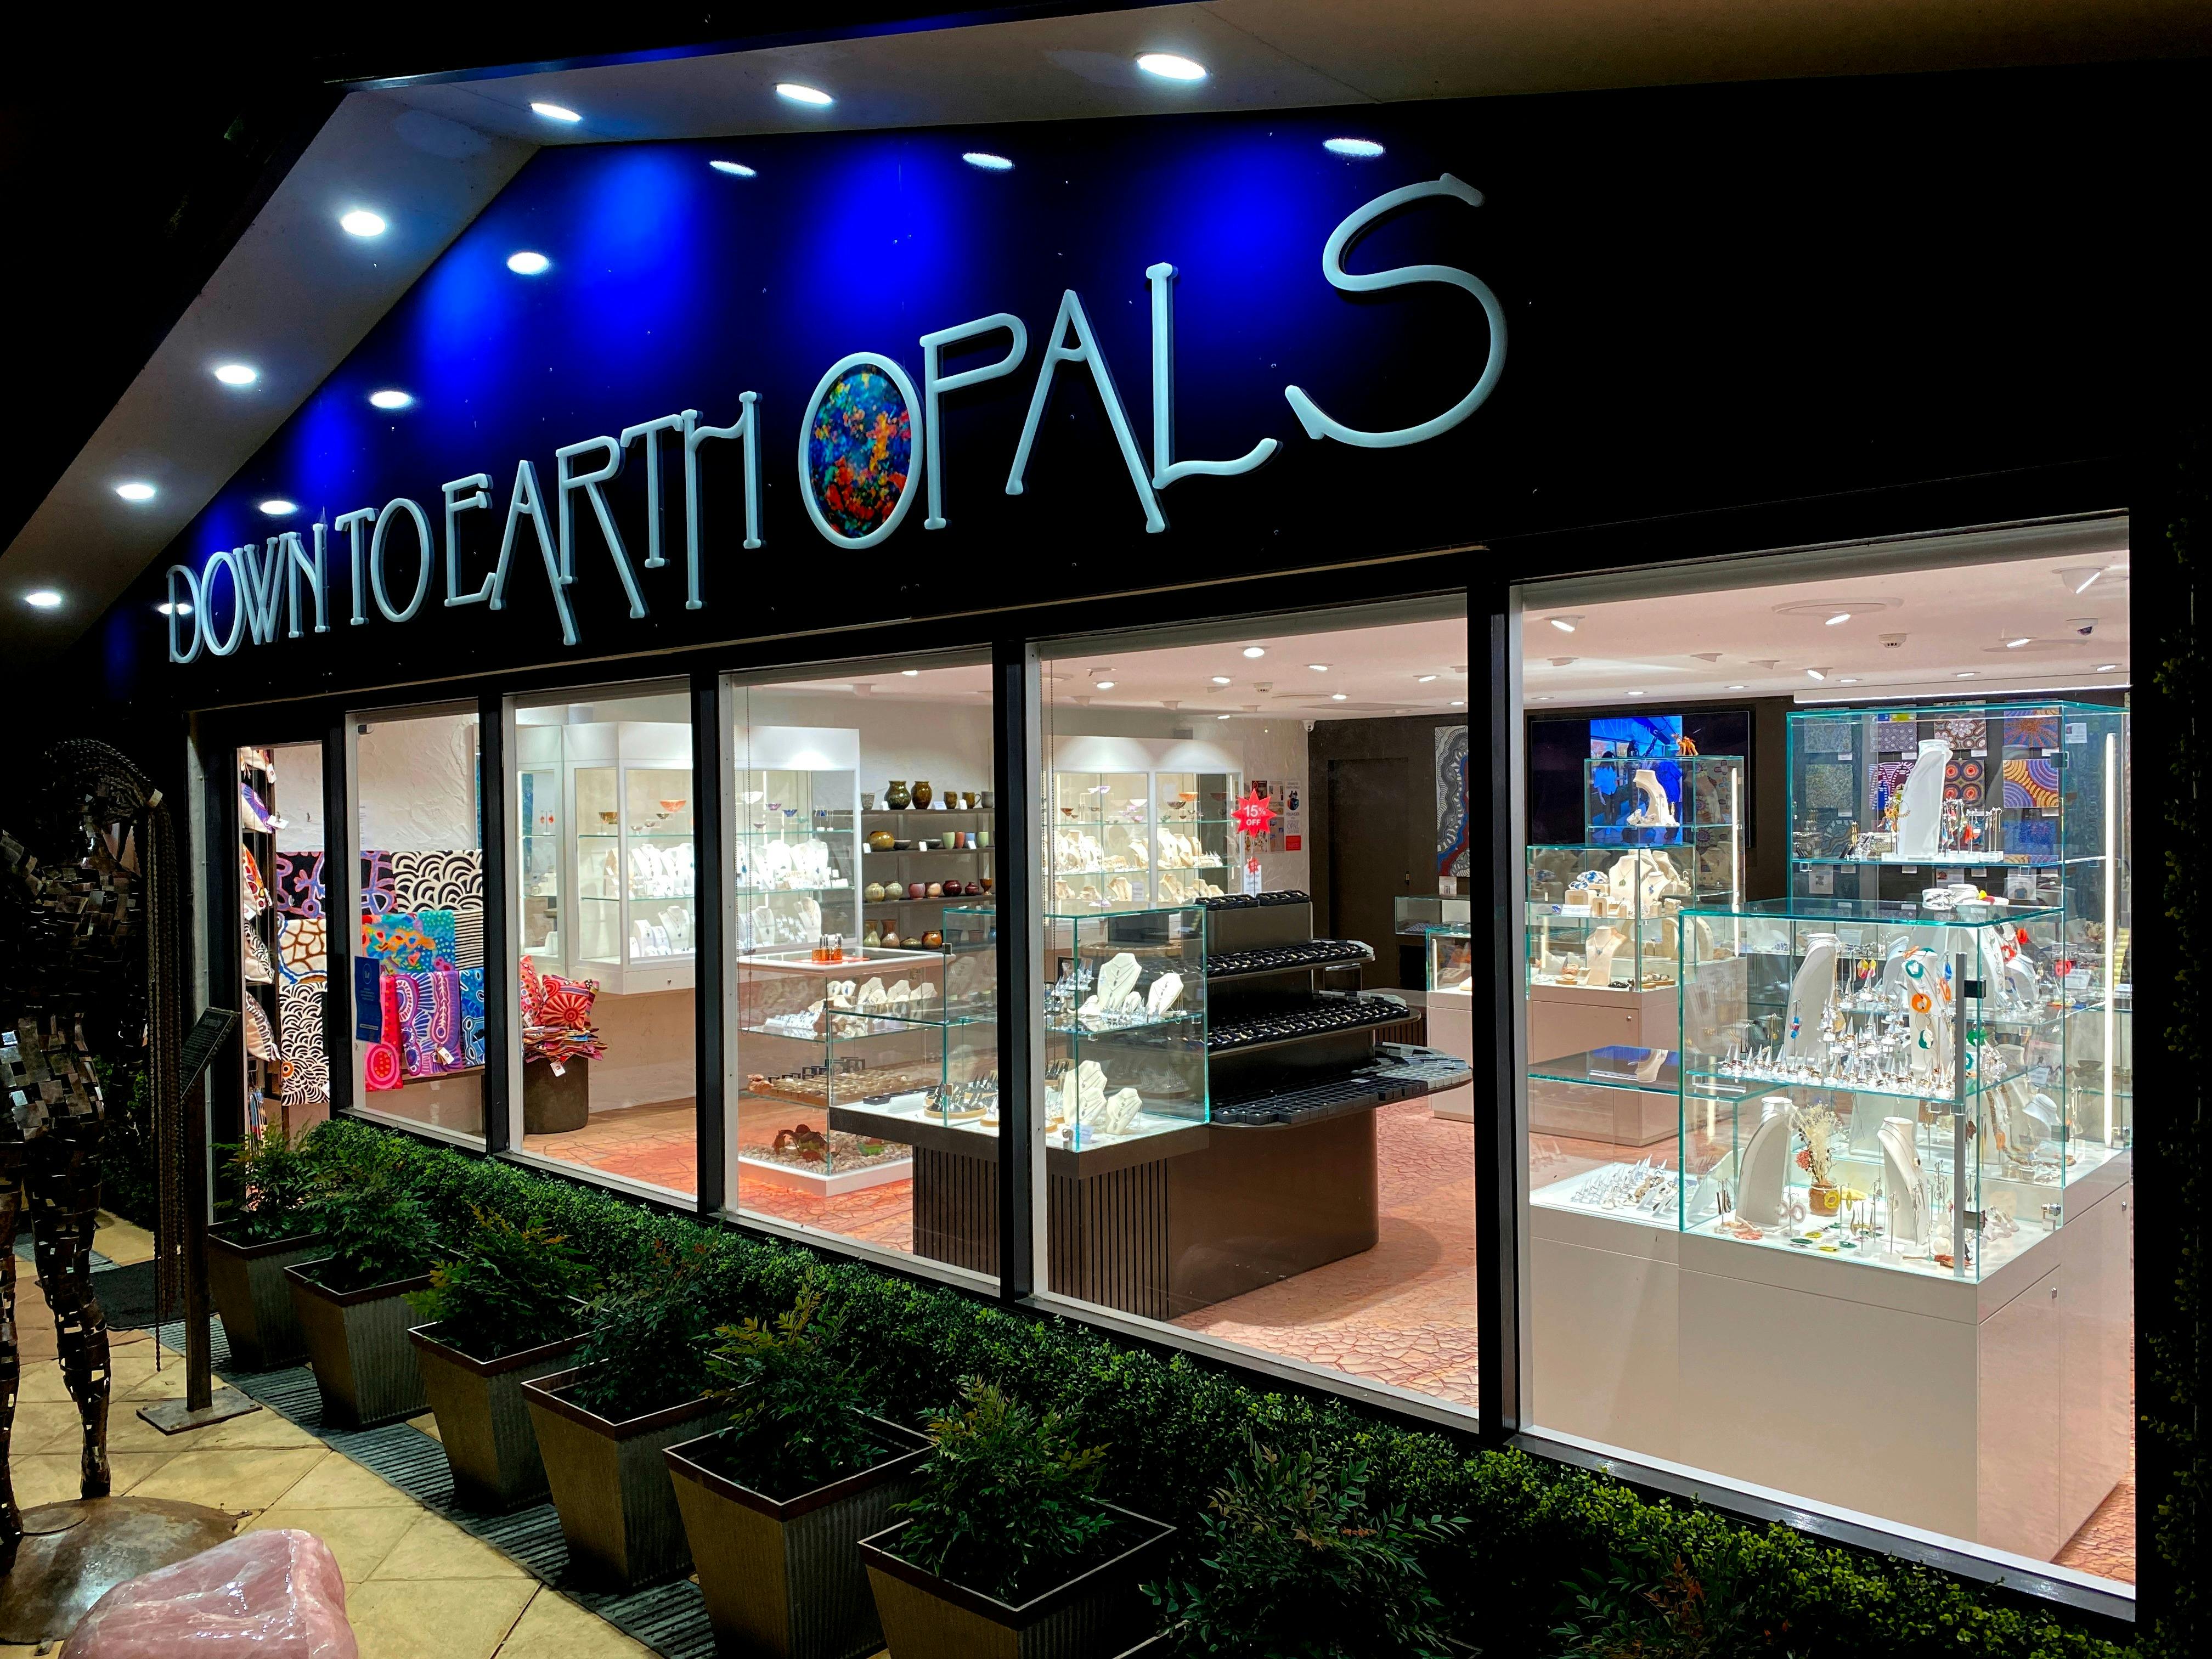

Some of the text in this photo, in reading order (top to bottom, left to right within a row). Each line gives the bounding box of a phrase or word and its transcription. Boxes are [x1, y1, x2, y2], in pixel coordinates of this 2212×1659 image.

[166, 172, 1509, 664] DOWN TO EARTH OPALS
[1243, 804, 1266, 817] 15%
